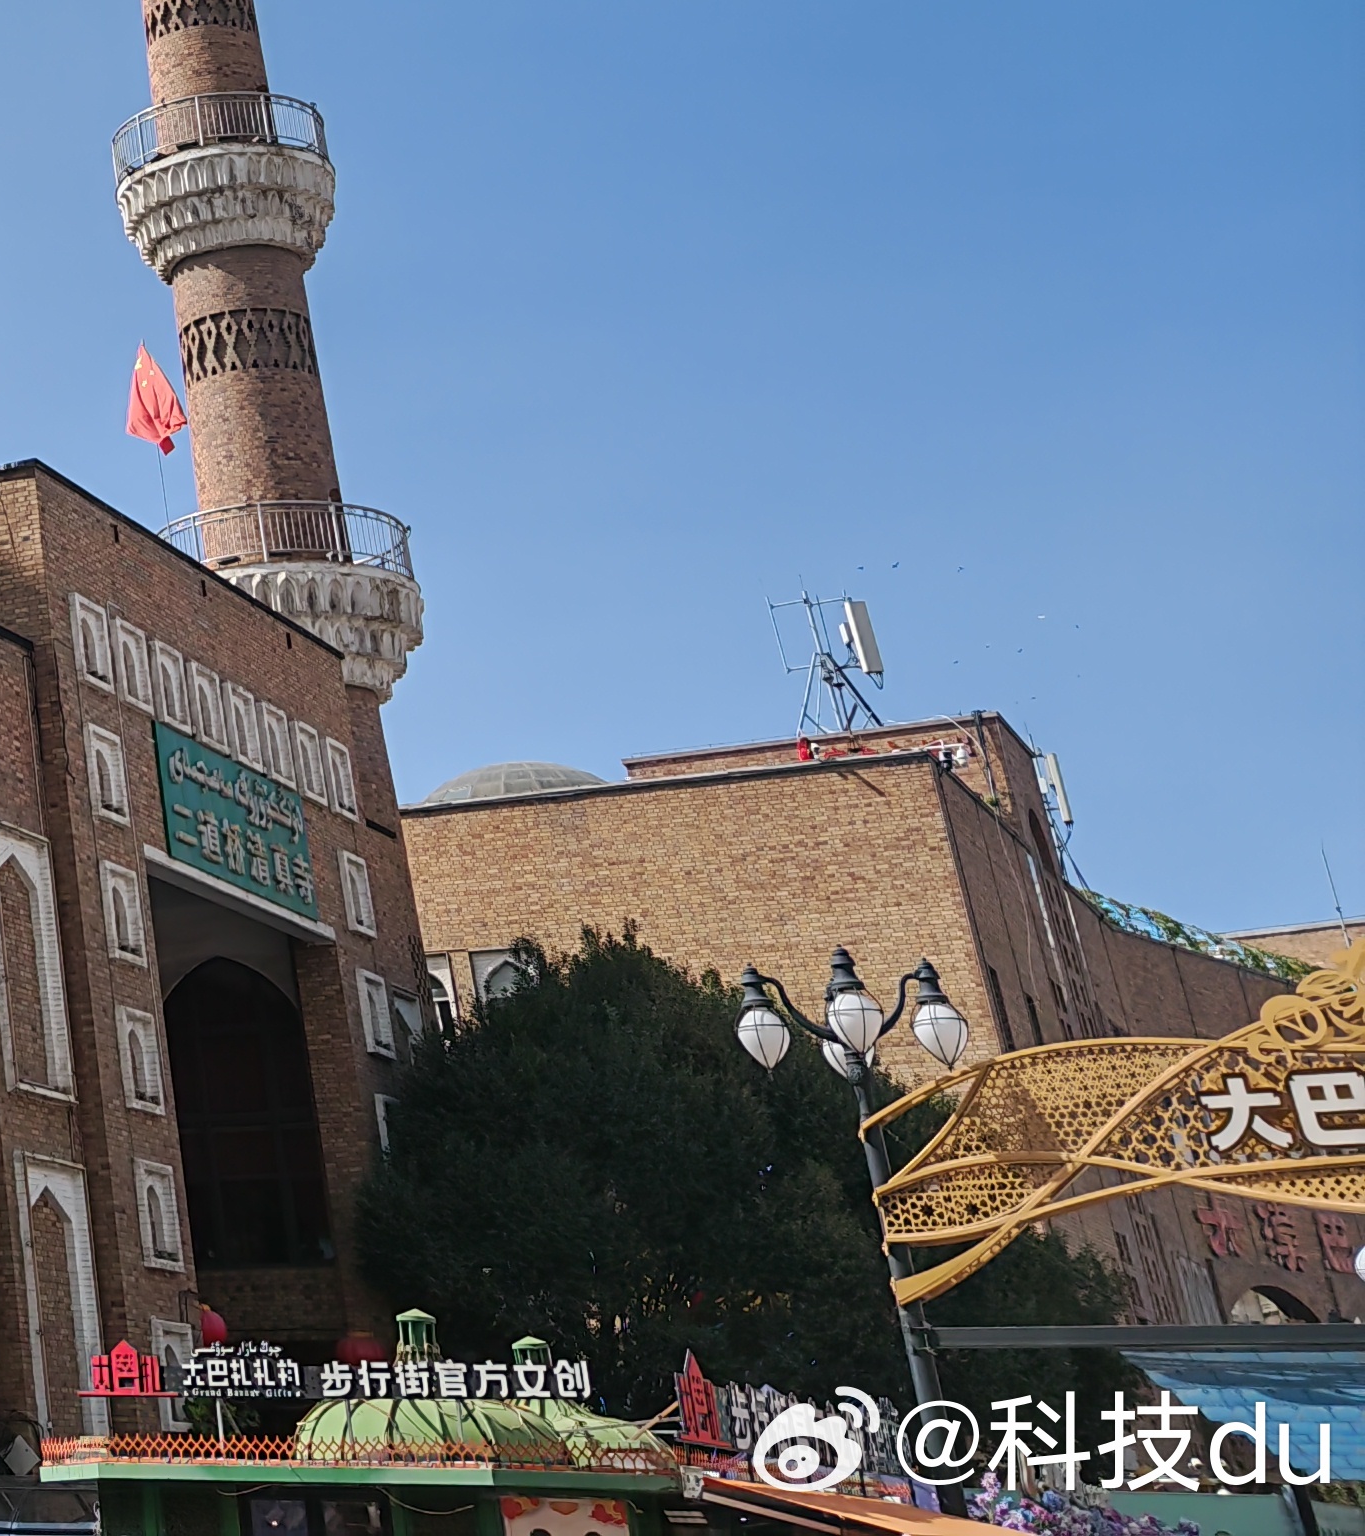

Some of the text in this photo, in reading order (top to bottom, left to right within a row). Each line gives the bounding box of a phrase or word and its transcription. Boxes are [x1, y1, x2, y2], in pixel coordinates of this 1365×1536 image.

[1199, 1072, 1365, 1151] 大巴
[320, 1359, 592, 1399] 步行街官方文创
